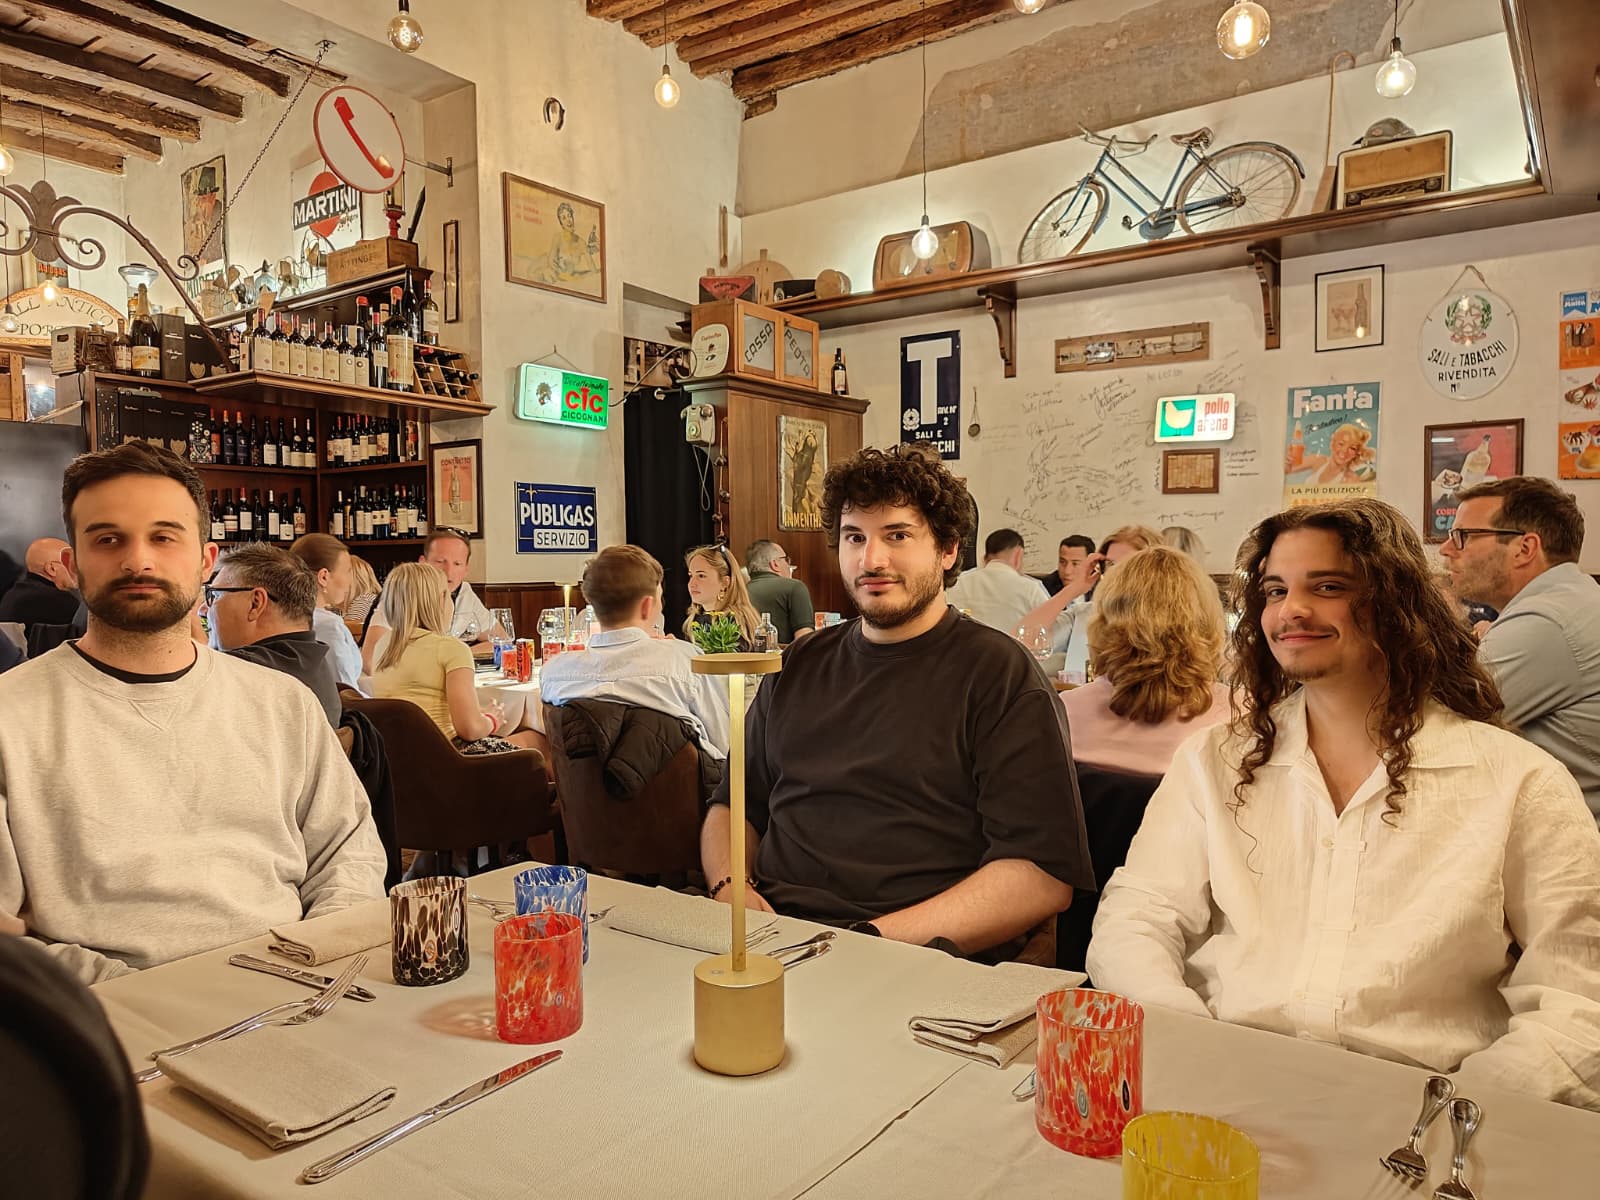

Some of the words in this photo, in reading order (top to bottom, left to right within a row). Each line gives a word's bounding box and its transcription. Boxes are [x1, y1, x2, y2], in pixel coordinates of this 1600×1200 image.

[294, 185, 356, 227] MARTINI
[47, 295, 114, 327] NTICO
[744, 322, 773, 363] CASSA
[1428, 348, 1450, 367] SALI
[1460, 339, 1508, 367] TABACCHI
[906, 337, 953, 425] T
[1438, 366, 1496, 382] RIVENDITA
[1204, 397, 1230, 416] pollo
[1293, 385, 1374, 418] Fanta
[561, 410, 607, 425] CICOGNANI
[1197, 417, 1229, 433] arena
[915, 430, 934, 440] SALI
[937, 429, 943, 438] E
[1291, 487, 1302, 495] LA
[520, 502, 595, 527] PUBLIGAS
[536, 531, 586, 546] SERVIZIO
